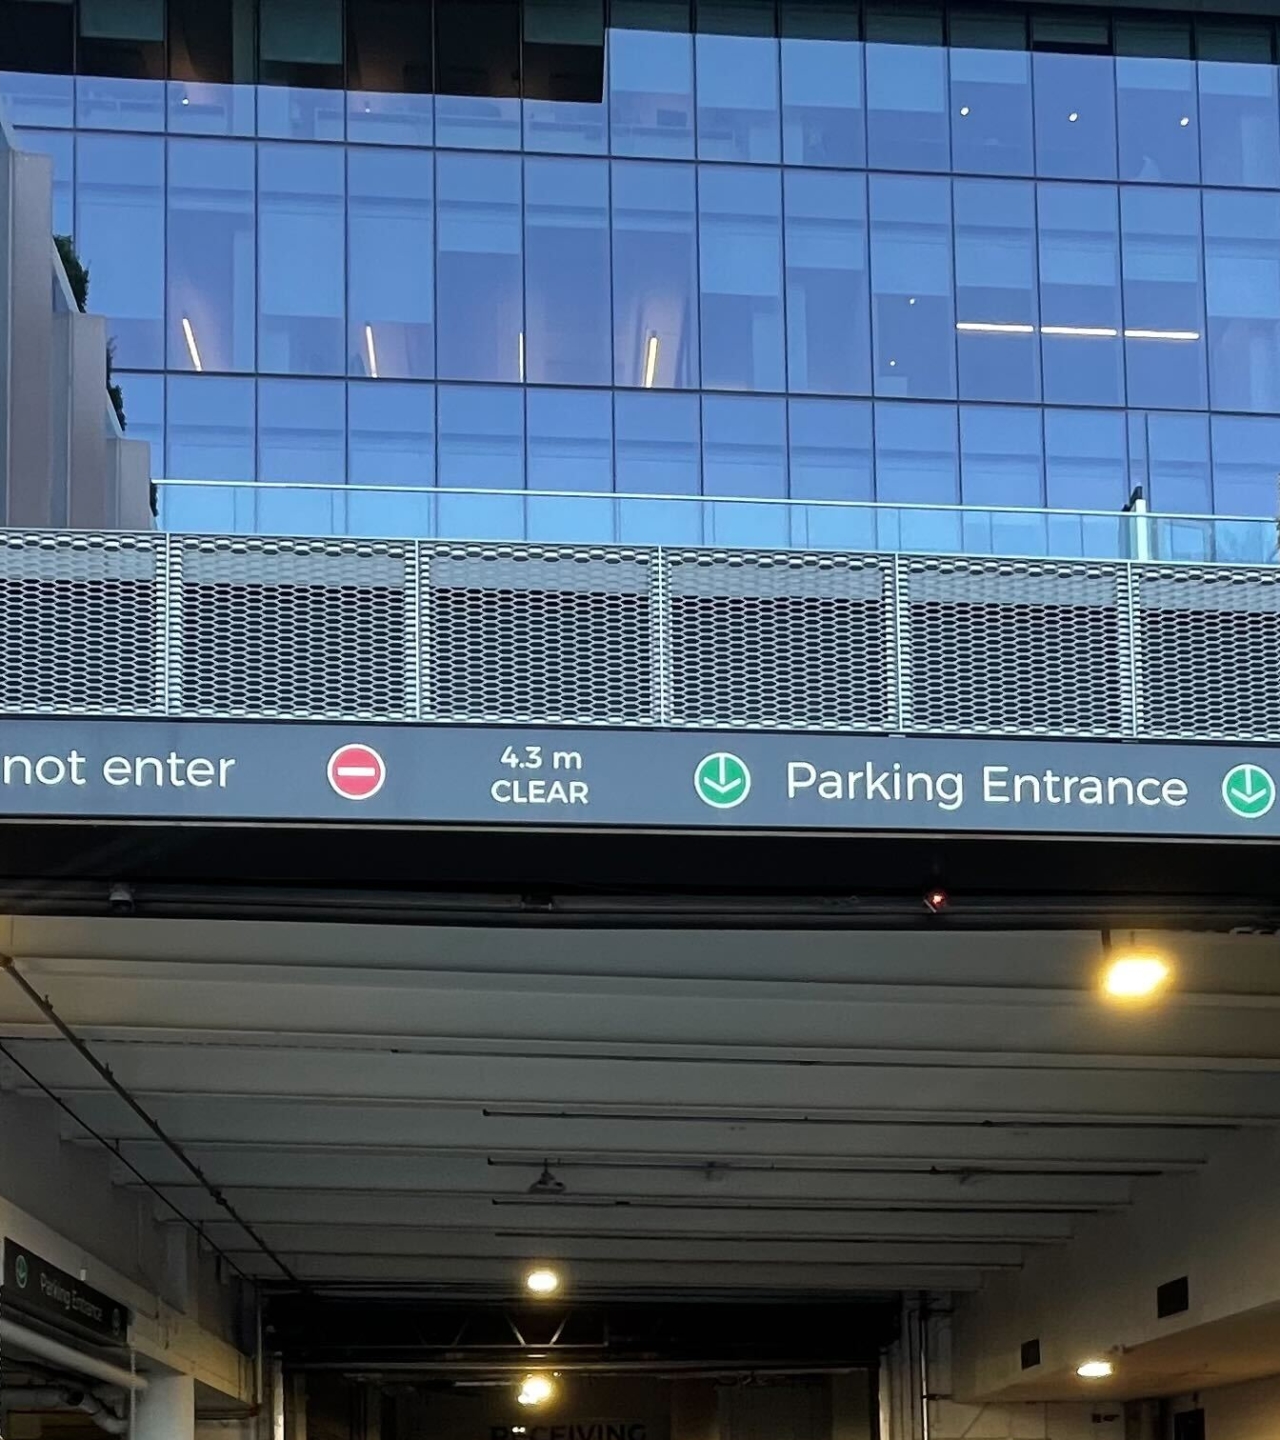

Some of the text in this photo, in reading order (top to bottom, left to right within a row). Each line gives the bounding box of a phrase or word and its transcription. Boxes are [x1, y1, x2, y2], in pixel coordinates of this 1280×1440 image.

[2, 750, 87, 786] not
[103, 751, 236, 788] enter
[500, 745, 582, 769] 4.3 m
[490, 779, 589, 804] CLEAR
[787, 761, 1189, 811] Parking Entrance
